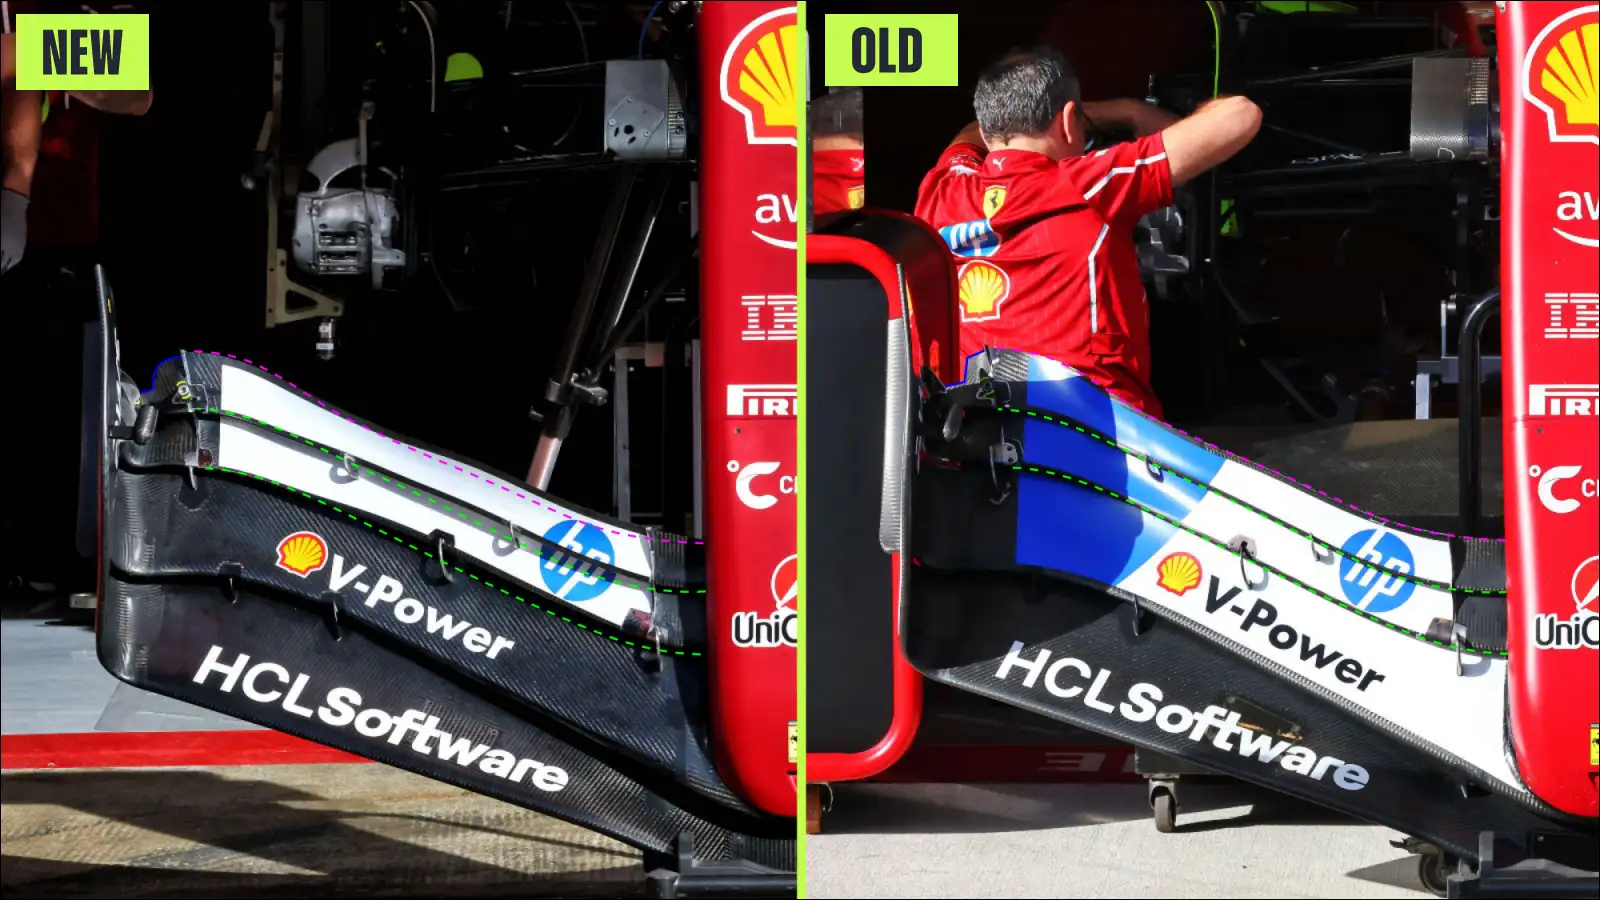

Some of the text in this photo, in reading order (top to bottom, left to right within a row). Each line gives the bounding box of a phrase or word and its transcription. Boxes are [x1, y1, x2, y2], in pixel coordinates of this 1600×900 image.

[727, 384, 798, 415] PIR
[1529, 384, 1599, 415] PIR
[326, 553, 515, 660] V-Power
[543, 520, 611, 600] hp
[1343, 528, 1411, 610] hp
[1204, 575, 1386, 694] V-Power
[192, 644, 570, 793] HCLSoftware
[993, 640, 1370, 790] HCLSoftware
